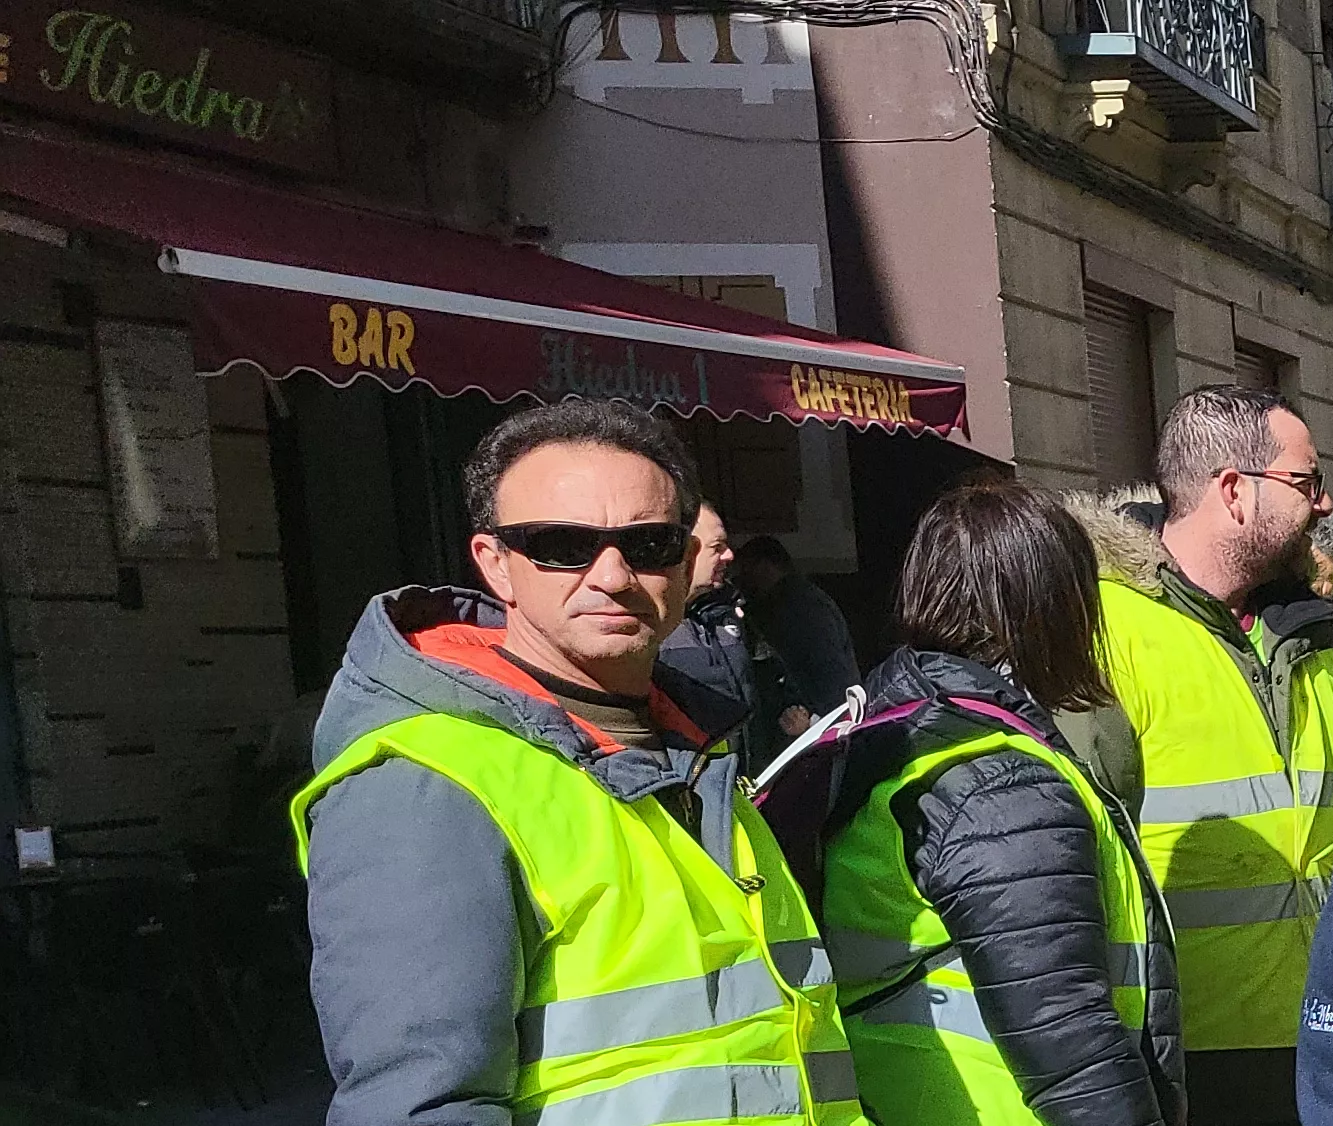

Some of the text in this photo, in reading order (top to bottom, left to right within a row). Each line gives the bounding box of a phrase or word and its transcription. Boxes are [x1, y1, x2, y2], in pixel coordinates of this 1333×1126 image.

[39, 10, 270, 142] Hiedra
[329, 303, 417, 376] BAR
[790, 363, 915, 423] CAFETERIA
